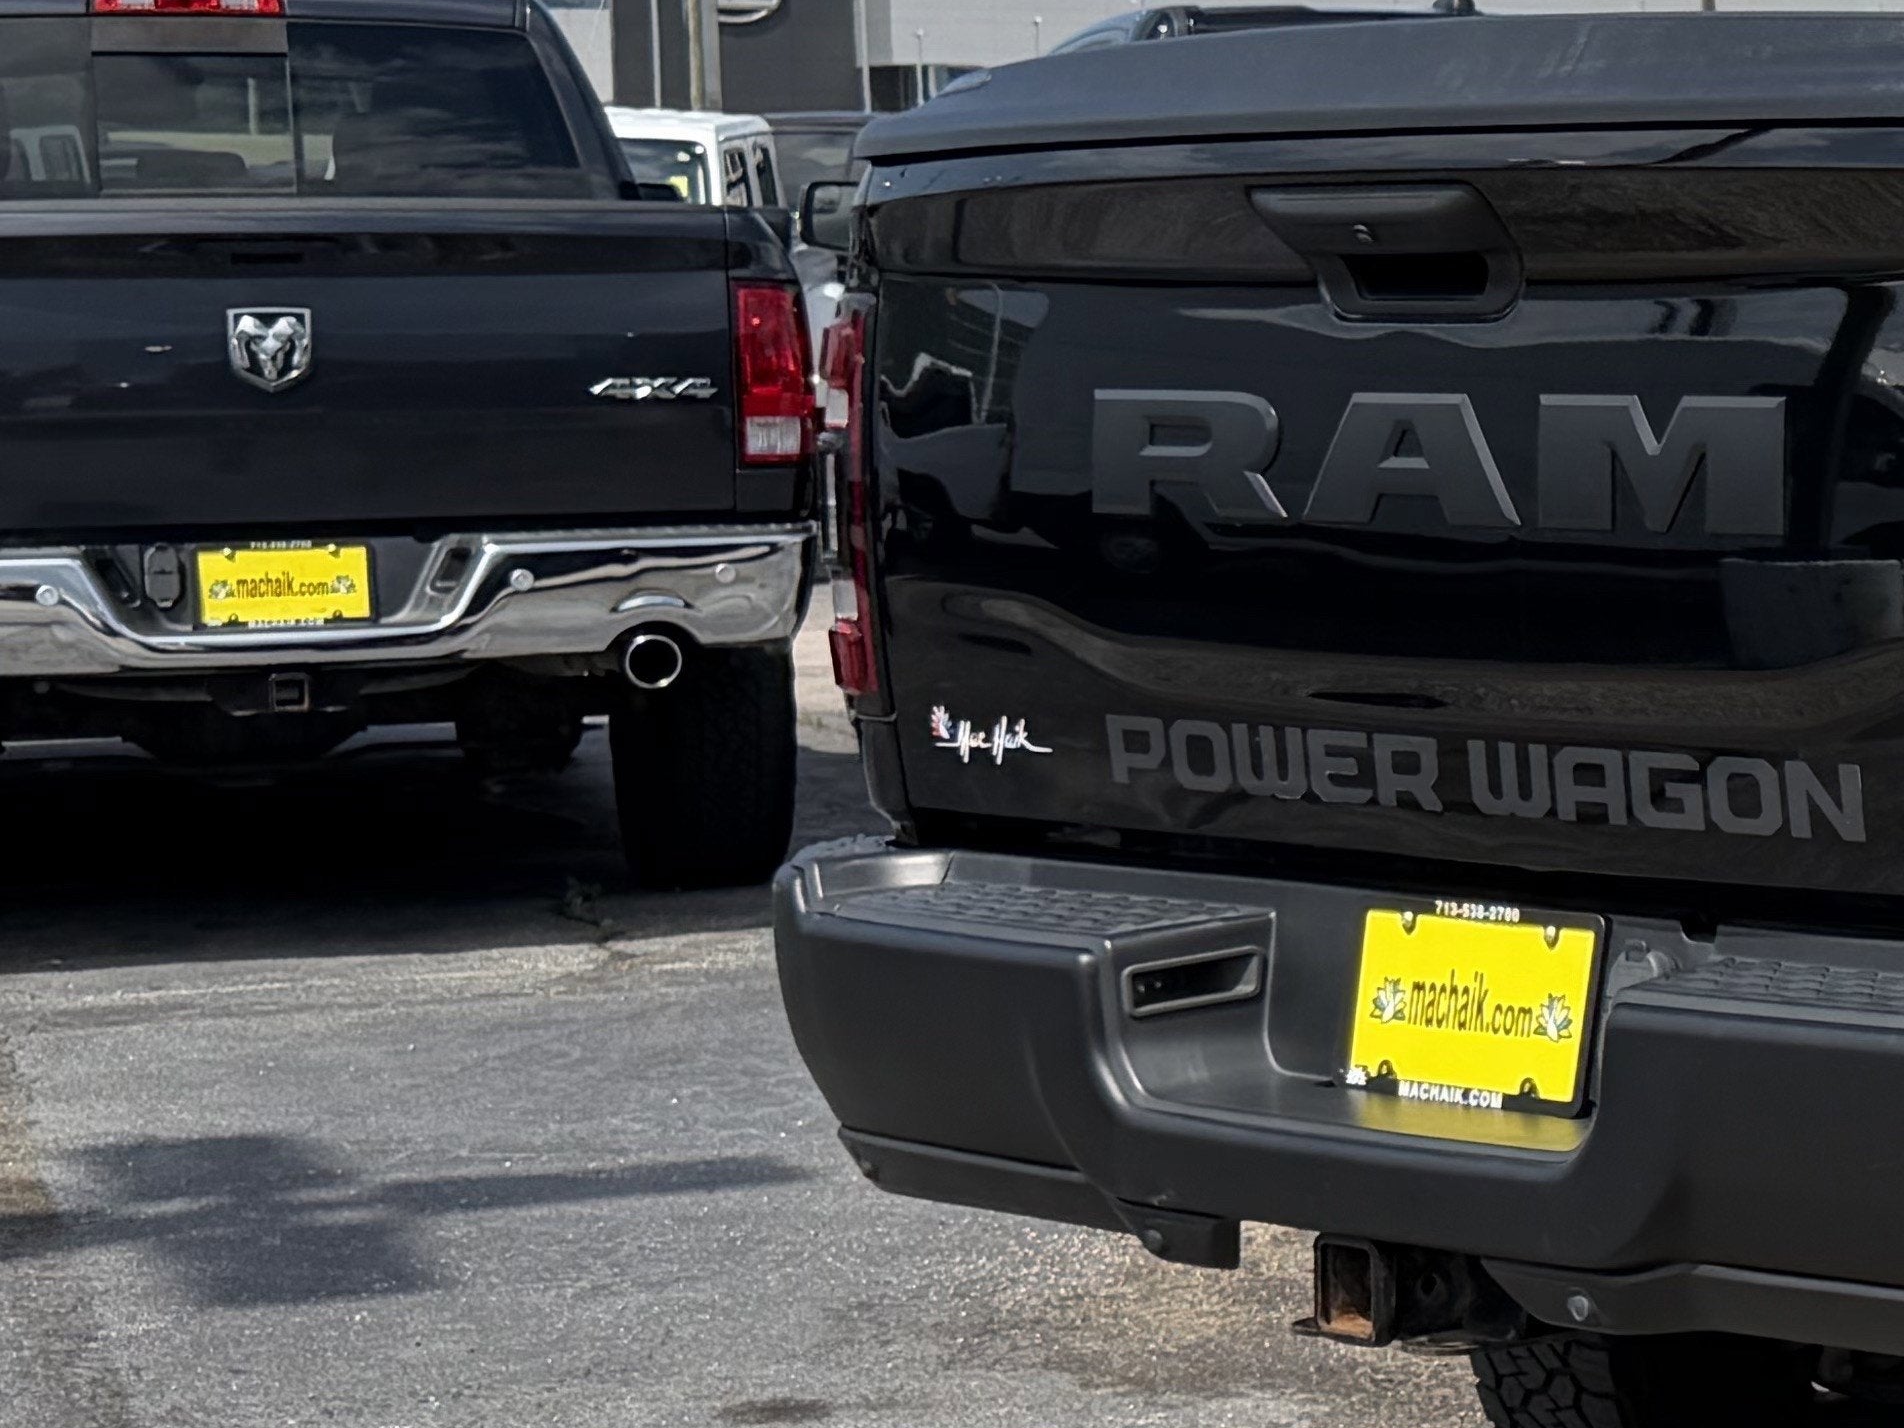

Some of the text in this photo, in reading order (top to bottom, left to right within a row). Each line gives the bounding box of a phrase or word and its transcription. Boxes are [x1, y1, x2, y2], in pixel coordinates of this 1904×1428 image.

[1091, 388, 1788, 537] RAM
[235, 571, 330, 599] machaik.com
[1104, 713, 1868, 843] POWER WAGON
[1406, 968, 1534, 1039] machaik.com
[1397, 1079, 1503, 1109] MACHAIK.COM
